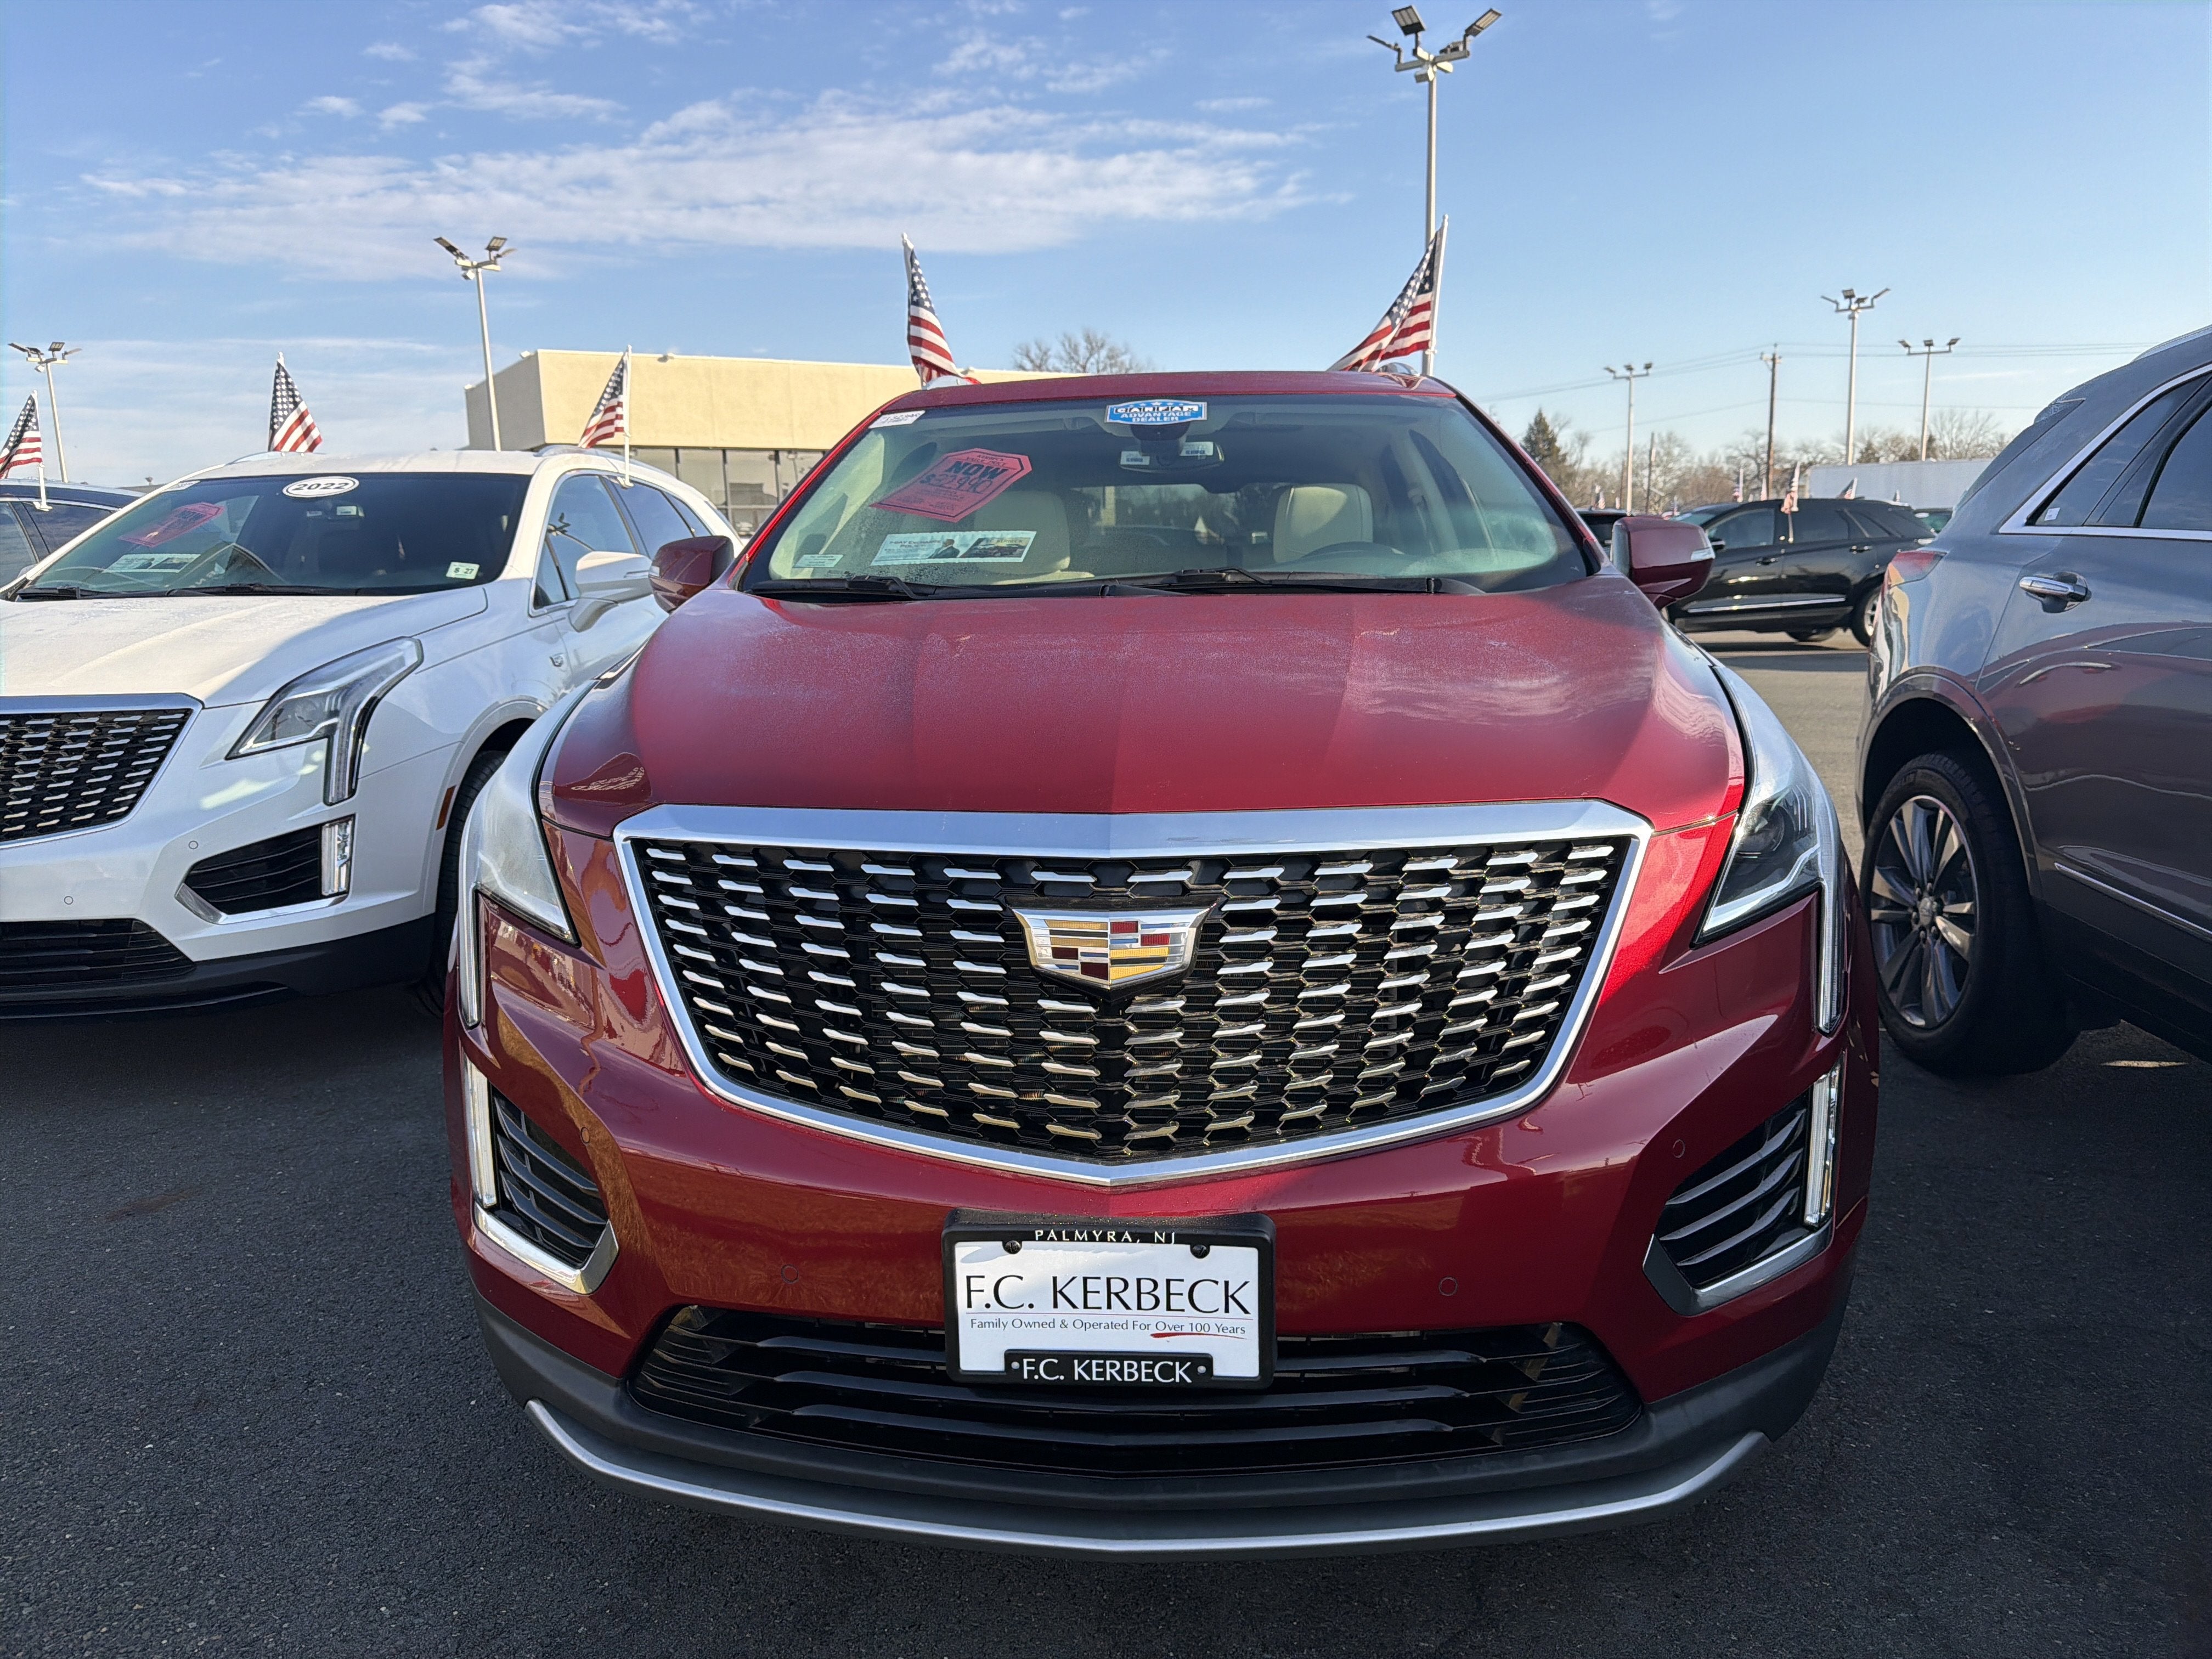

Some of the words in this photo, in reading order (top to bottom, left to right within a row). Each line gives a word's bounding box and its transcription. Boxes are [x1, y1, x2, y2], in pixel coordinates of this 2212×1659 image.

[945, 461, 1009, 479] NOW
[292, 482, 349, 490] 2022
[1035, 1228, 1140, 1244] PALMYRA,
[1154, 1231, 1175, 1245] NJ
[966, 1274, 1034, 1309] F.C.
[1052, 1275, 1251, 1314] KERBECK
[970, 1318, 1008, 1331] Family
[1012, 1318, 1055, 1329] Owned
[1059, 1319, 1069, 1329] &
[1073, 1319, 1128, 1331] Operated
[1132, 1321, 1151, 1331] For
[1155, 1321, 1184, 1331] Over
[1189, 1322, 1210, 1333] 100
[1215, 1323, 1245, 1334] Years
[1023, 1358, 1064, 1381] F.C.
[1074, 1360, 1192, 1383] KERBECK
